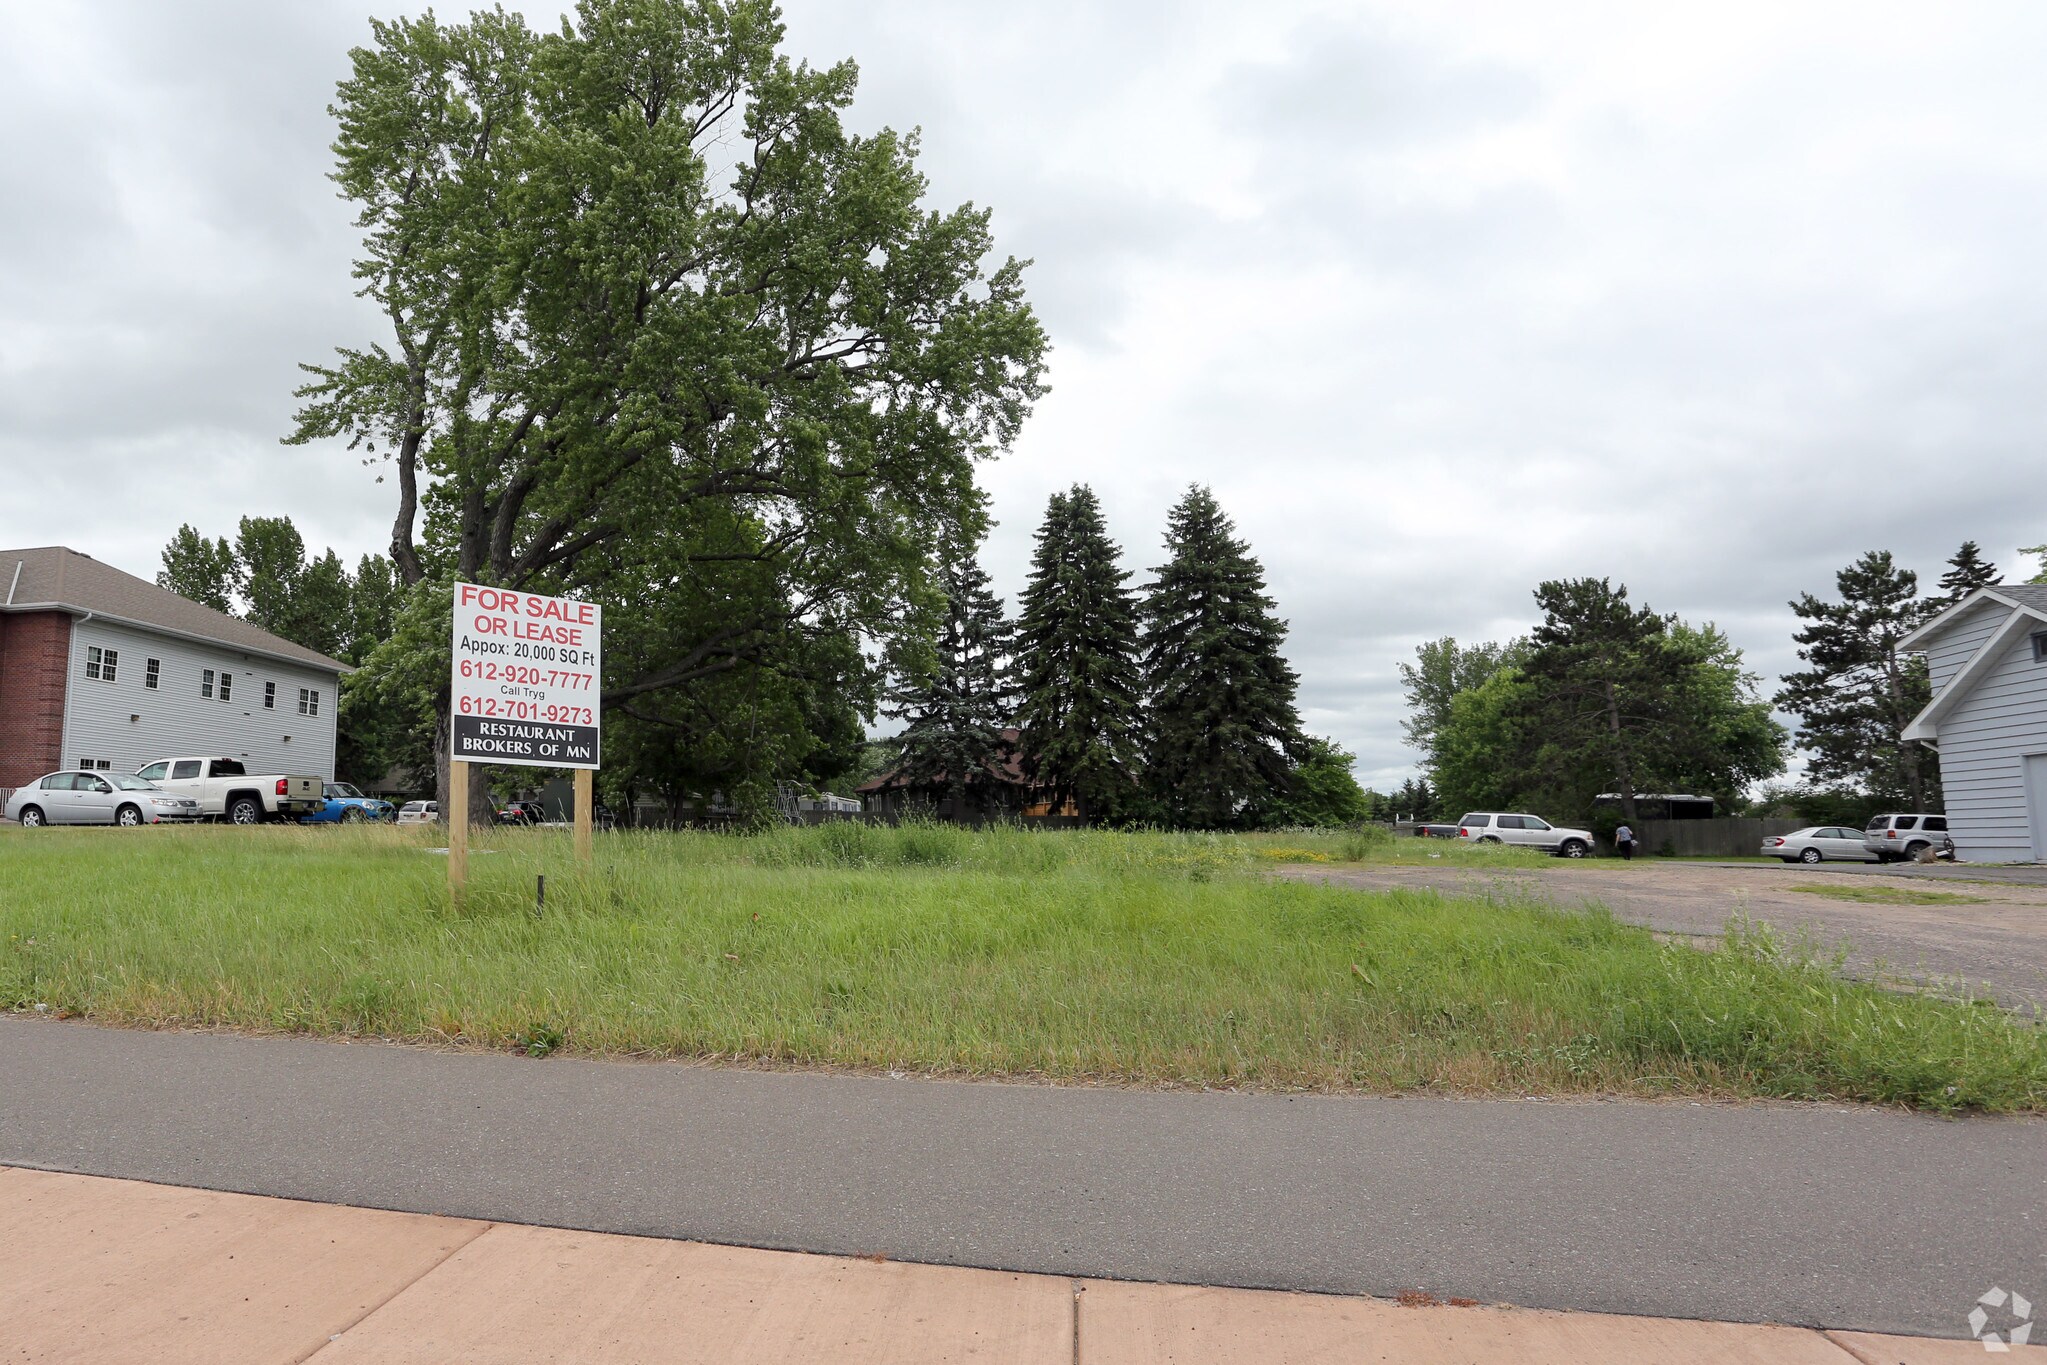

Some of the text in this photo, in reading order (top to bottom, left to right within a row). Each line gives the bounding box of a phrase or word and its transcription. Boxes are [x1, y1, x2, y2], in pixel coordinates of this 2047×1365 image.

[461, 585, 594, 625] FOR SALE
[474, 615, 582, 646] OR LEASE
[460, 635, 595, 667] Appox: 20,000 SQ Ft
[460, 659, 593, 691] 612-920-7777
[500, 685, 545, 701] Call Tryg
[459, 695, 593, 725] 612-701-9273
[479, 722, 576, 742] RESTAURANT
[462, 737, 590, 759] BROKERS OF MN
